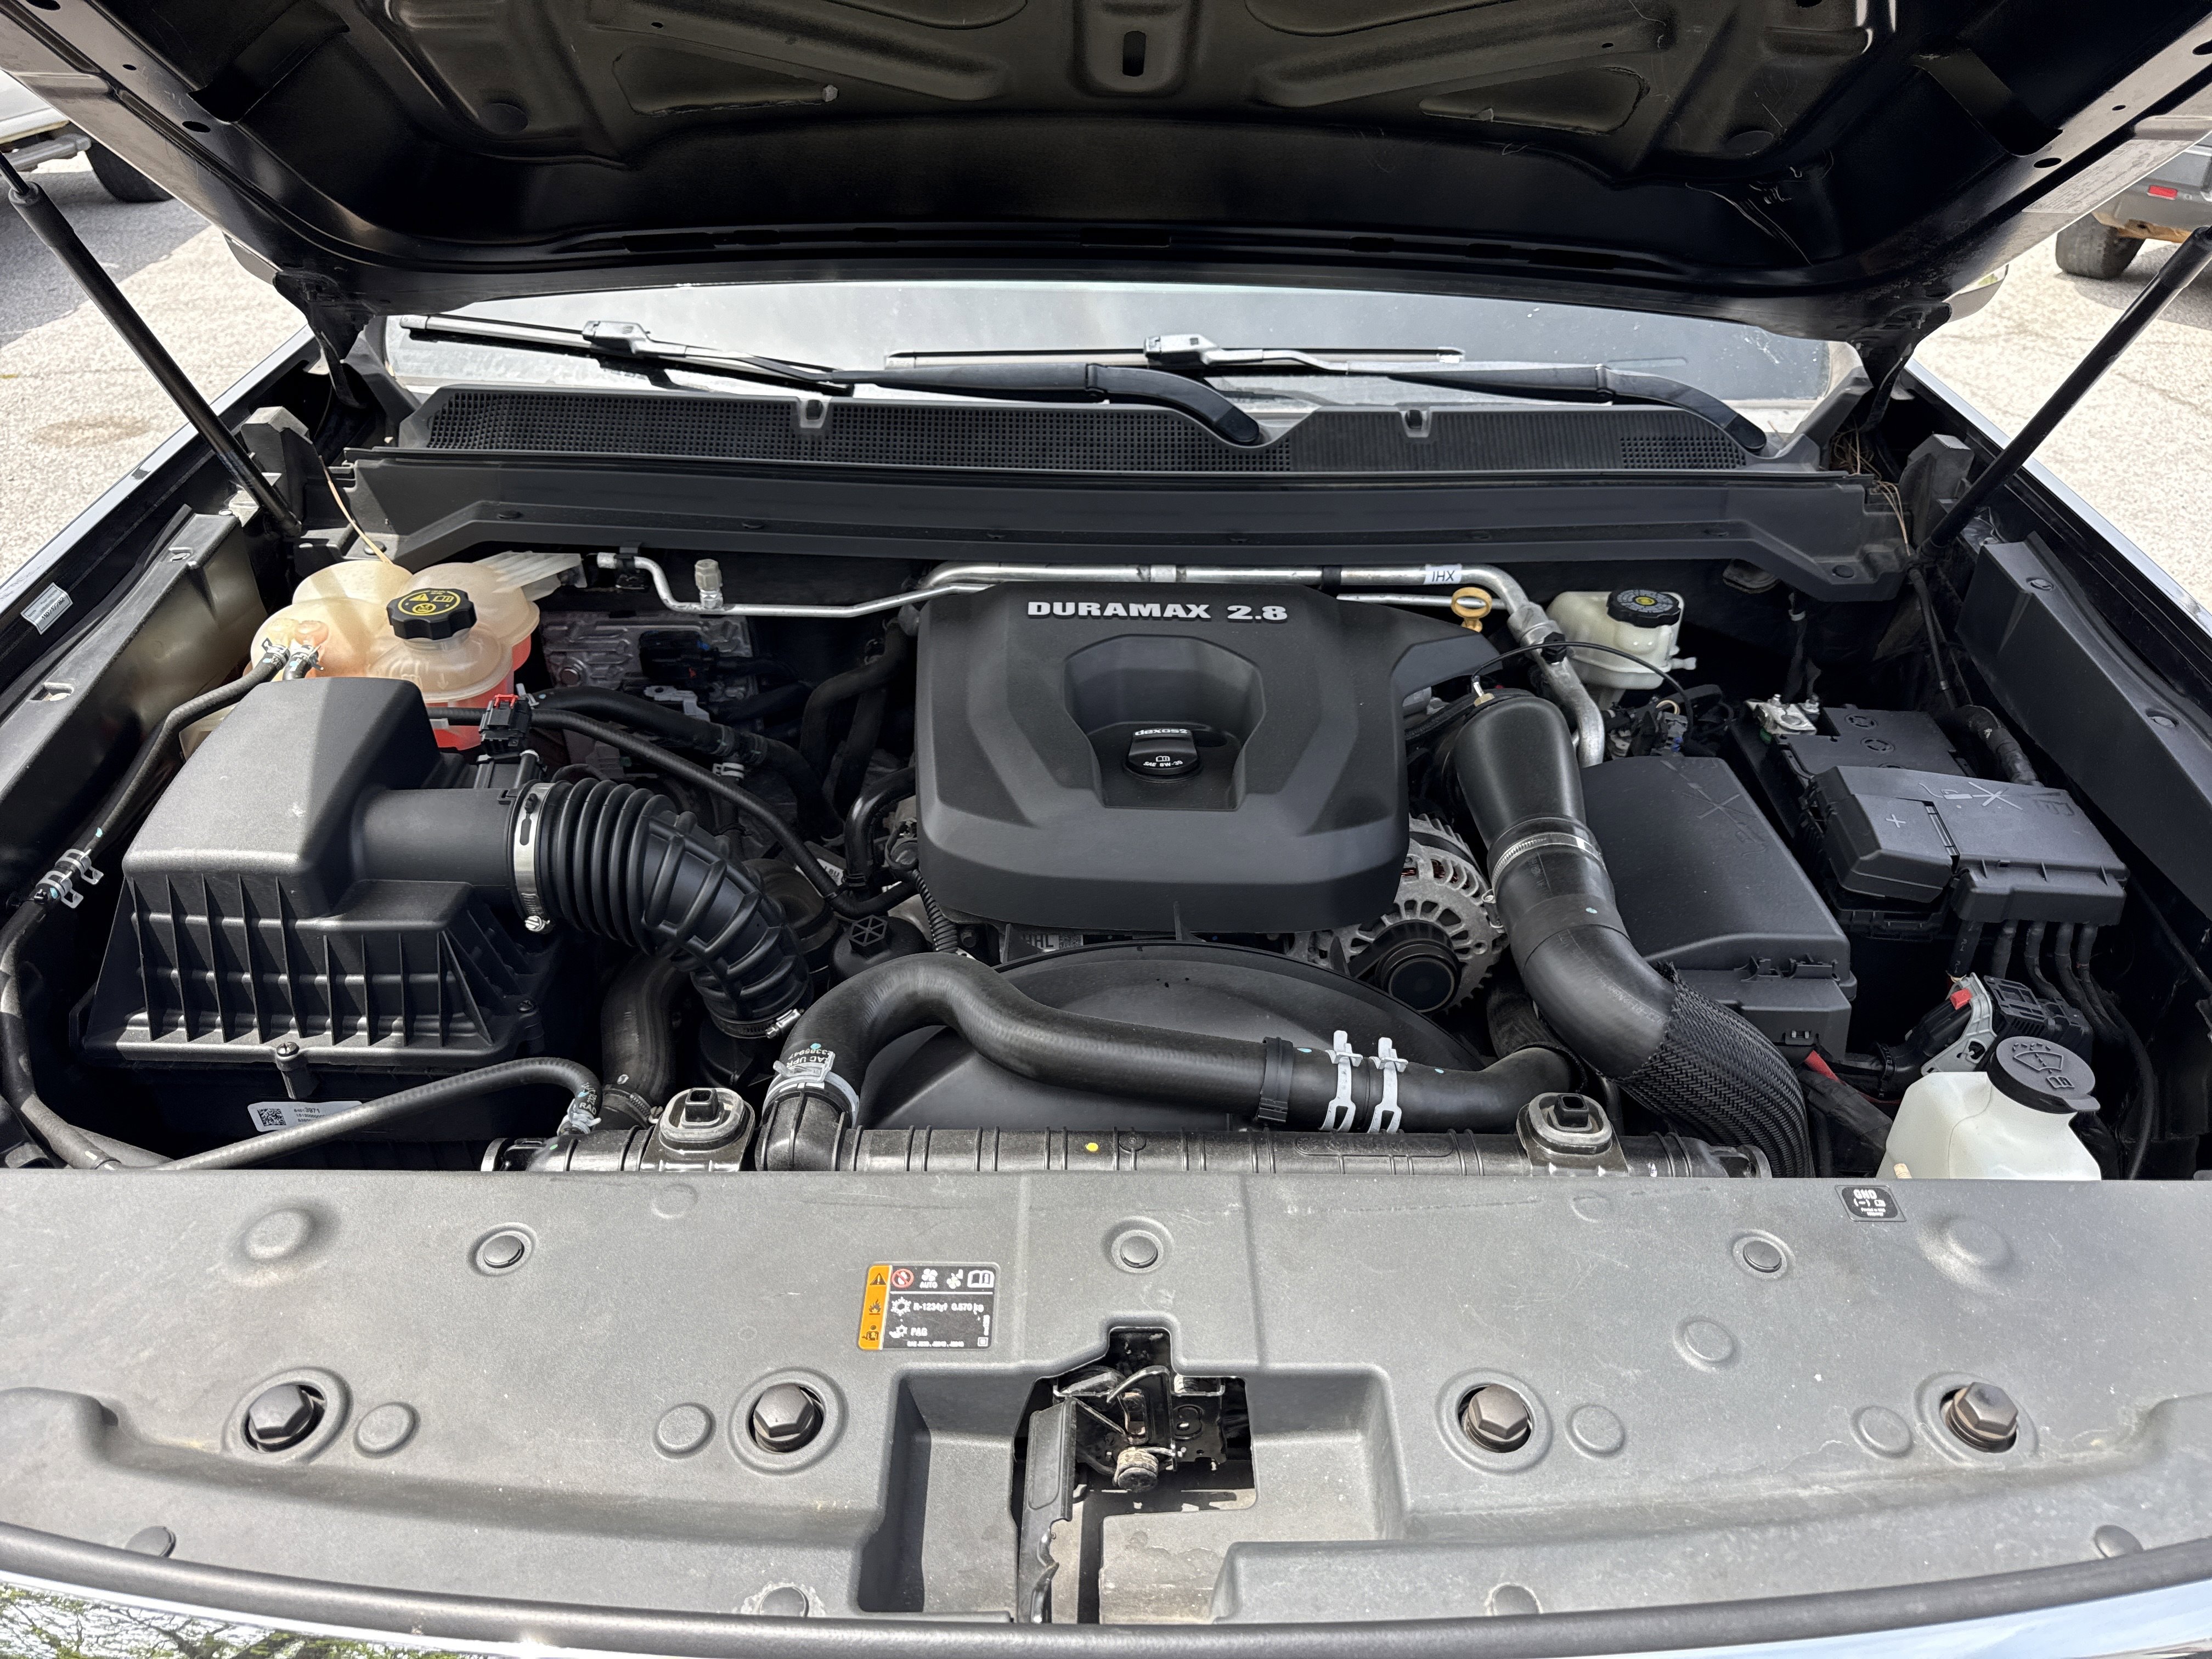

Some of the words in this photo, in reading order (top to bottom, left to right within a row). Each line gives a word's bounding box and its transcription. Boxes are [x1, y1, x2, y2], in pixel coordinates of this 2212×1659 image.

[1028, 602, 1211, 619] DURAMAX
[1227, 605, 1288, 621] 2.8
[579, 1102, 597, 1115] RAD
[1853, 1189, 1877, 1199] GND
[910, 1328, 928, 1336] PAG
